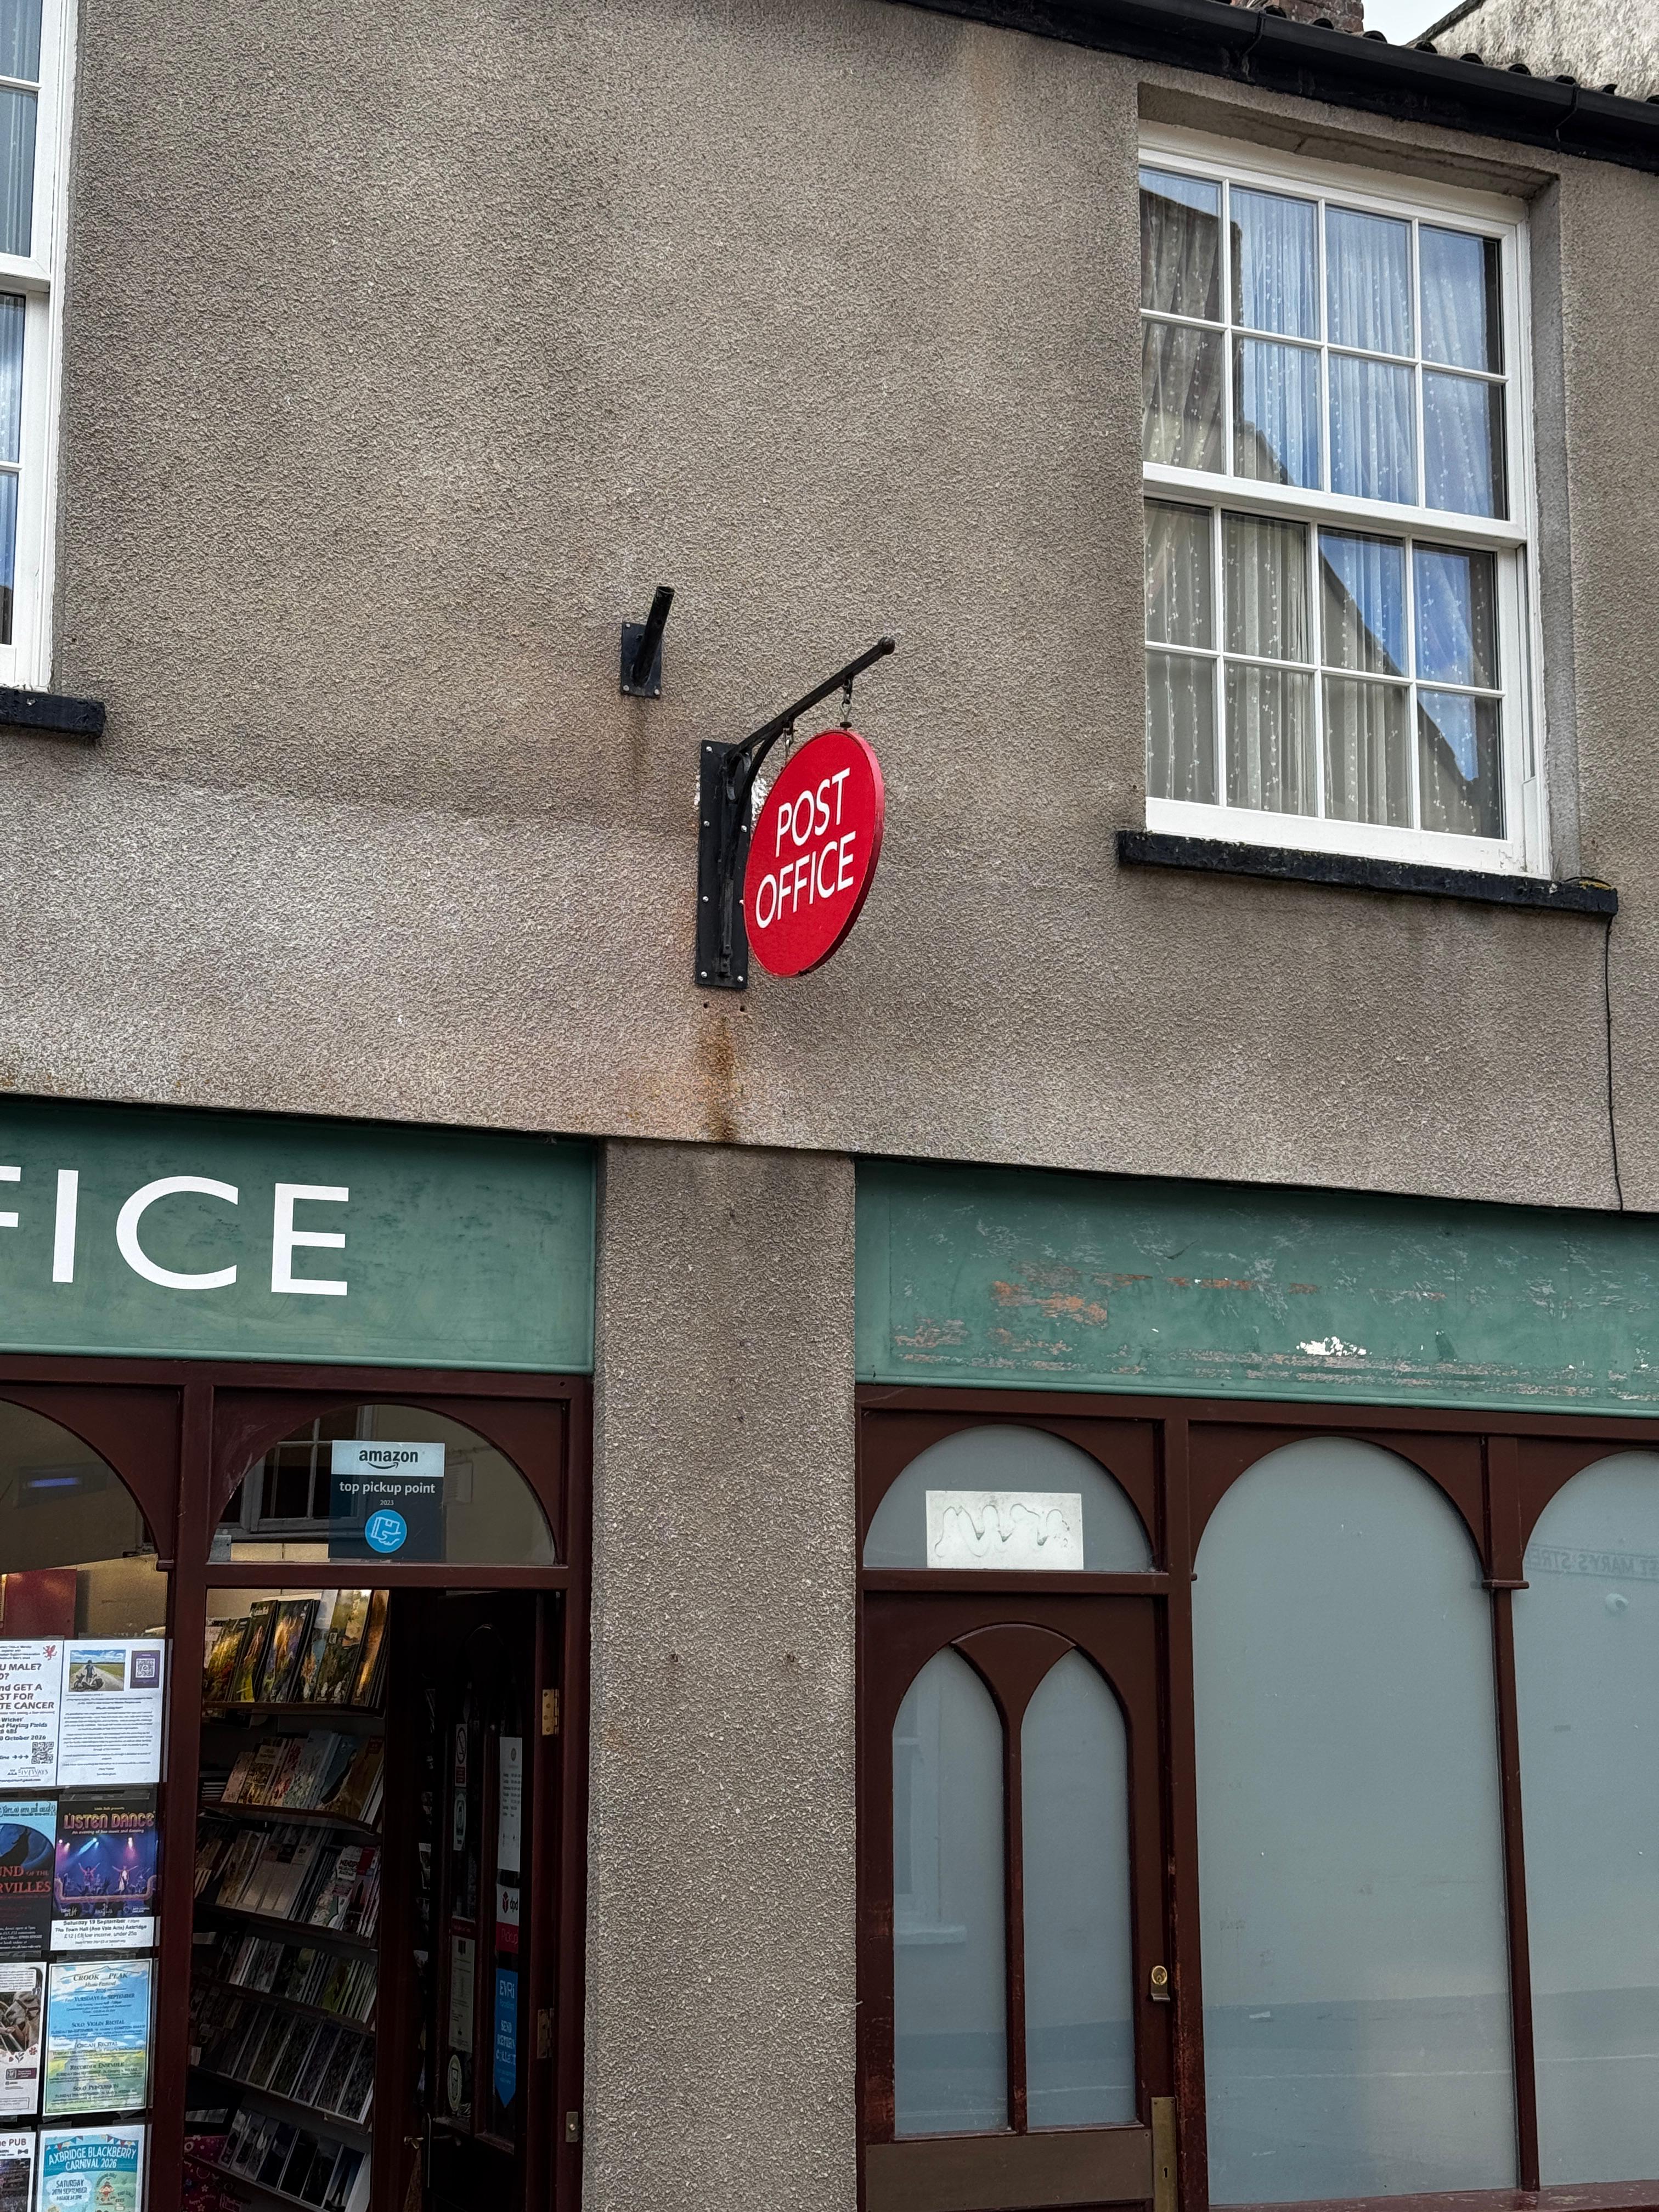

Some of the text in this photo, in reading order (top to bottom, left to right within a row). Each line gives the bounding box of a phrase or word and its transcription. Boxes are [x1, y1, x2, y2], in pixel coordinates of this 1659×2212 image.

[775, 768, 850, 857] POST
[755, 831, 856, 929] OFFICE
[359, 1449, 418, 1463] amazon
[340, 1481, 436, 1495] top pickup point
[9, 2138, 27, 2146] PUB
[49, 2146, 137, 2166] AXBRIDGE BLACKBERRY
[66, 2159, 118, 2171] CARNIVAL 2026
